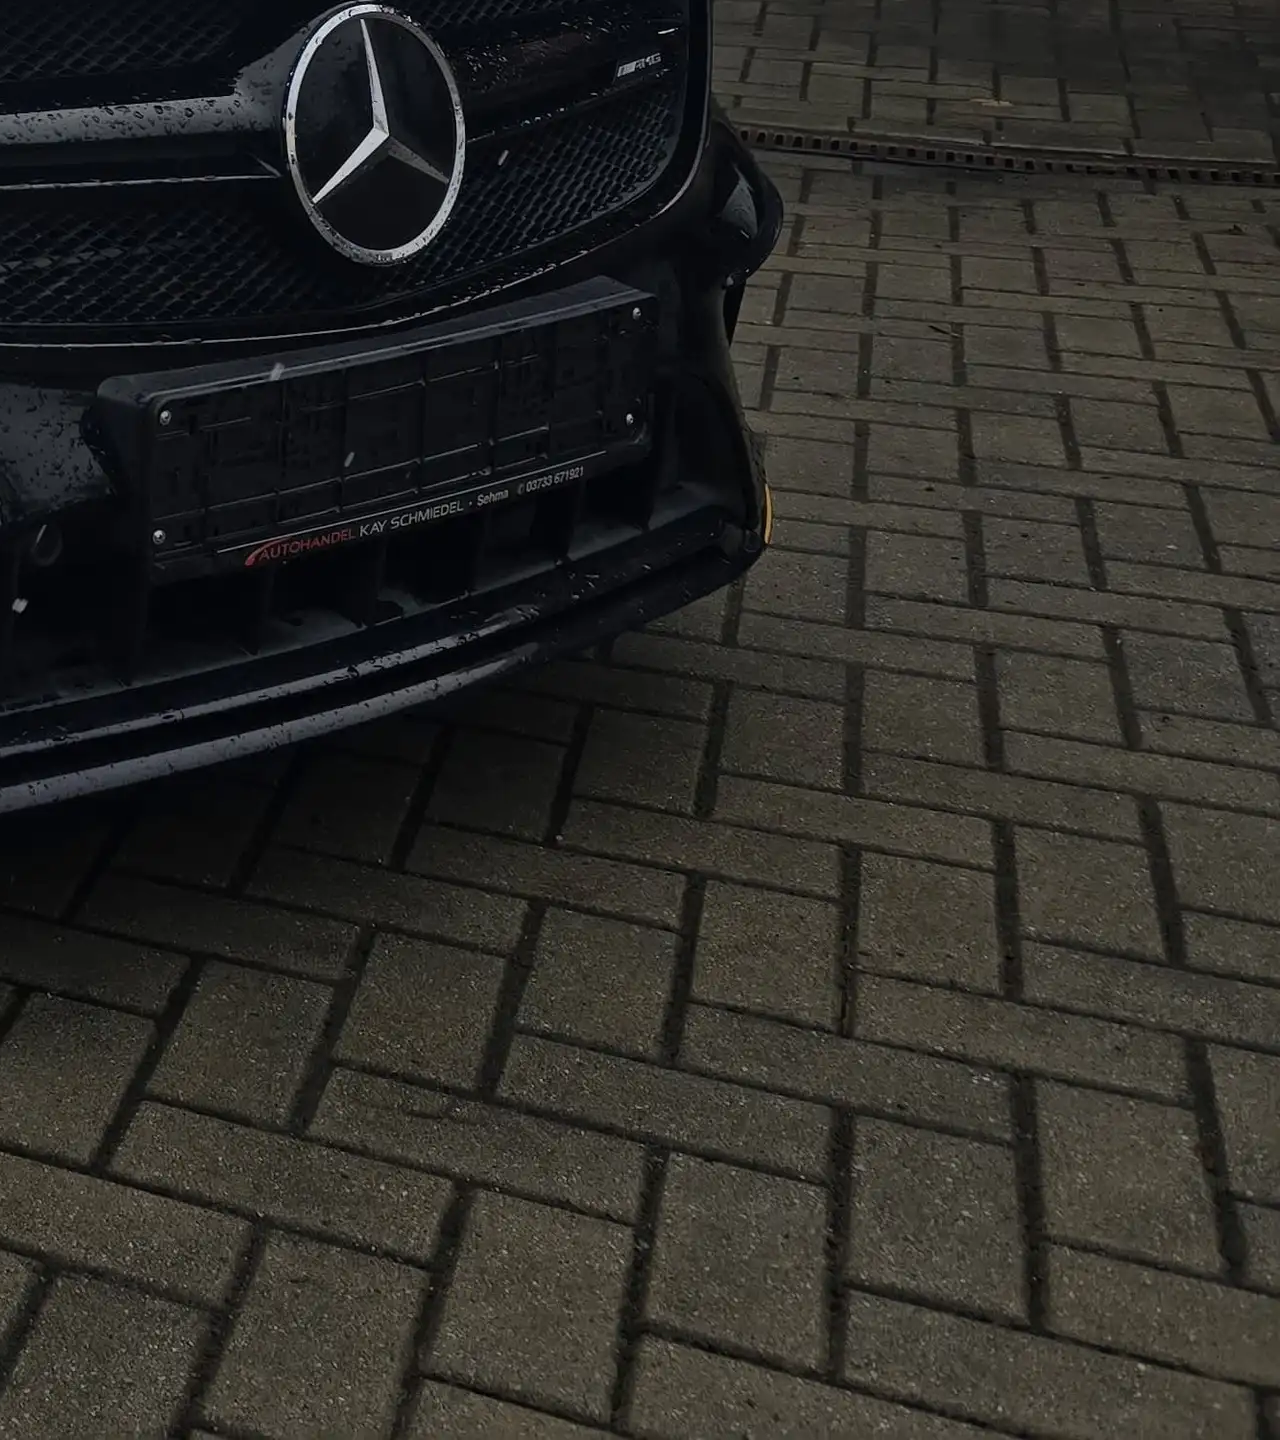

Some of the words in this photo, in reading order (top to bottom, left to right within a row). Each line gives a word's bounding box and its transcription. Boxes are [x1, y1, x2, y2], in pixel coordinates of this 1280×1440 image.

[258, 527, 357, 561] AUTOHANDEL
[359, 519, 387, 538] KAY
[390, 500, 464, 530] SCHMIEDEL
[477, 489, 509, 506] Sehma
